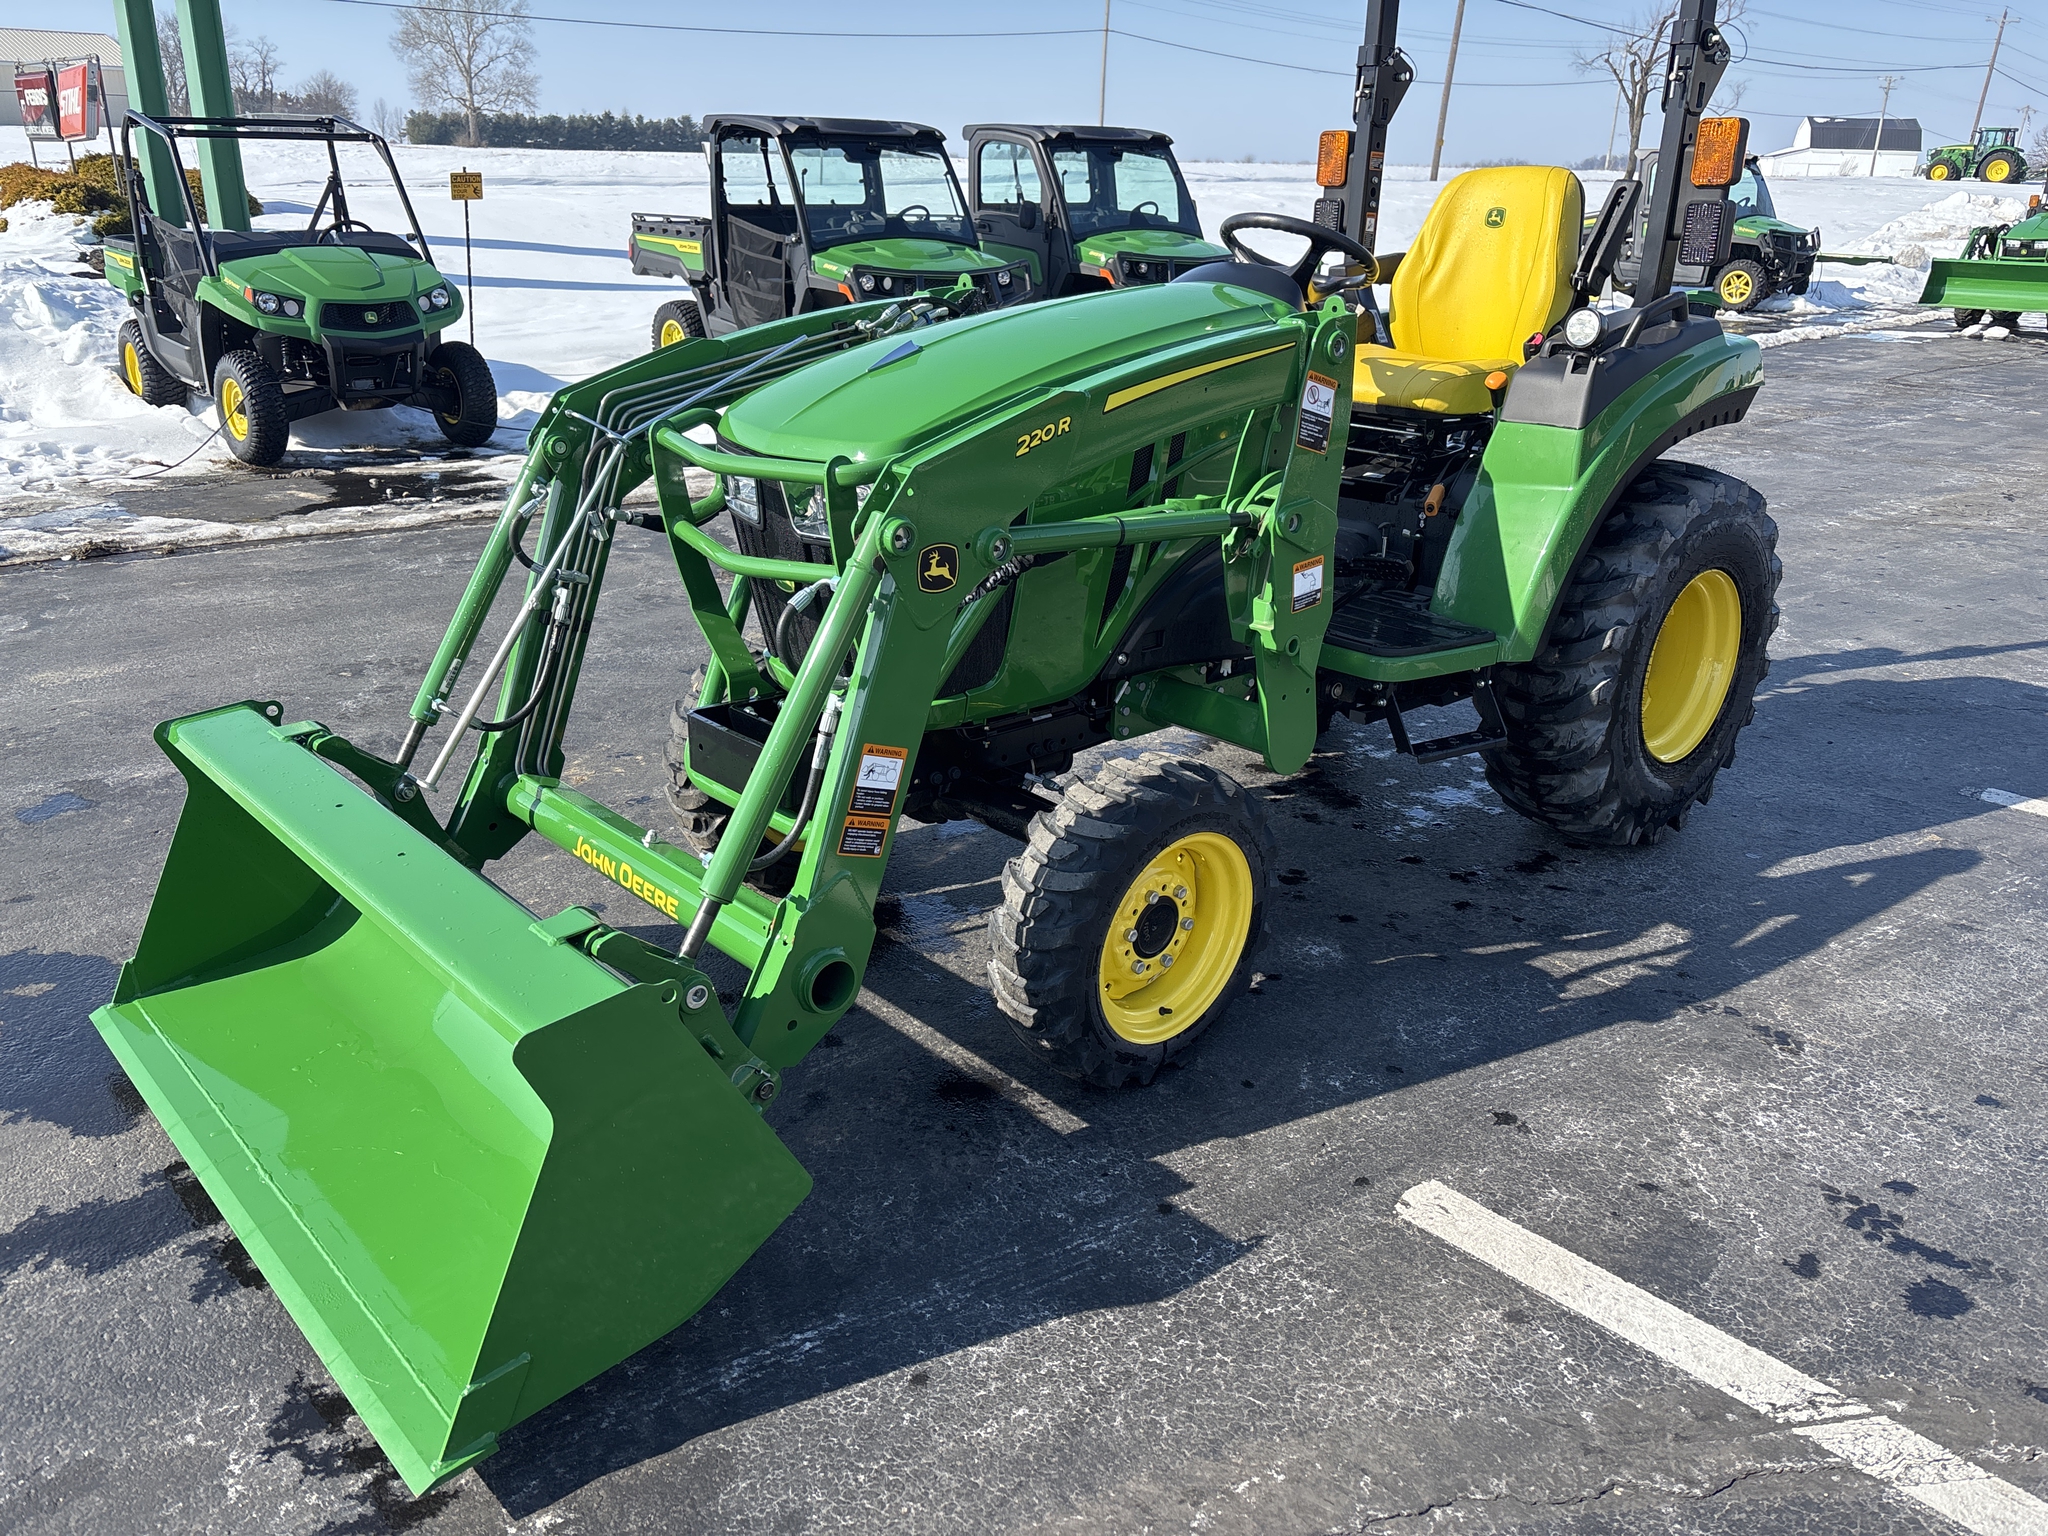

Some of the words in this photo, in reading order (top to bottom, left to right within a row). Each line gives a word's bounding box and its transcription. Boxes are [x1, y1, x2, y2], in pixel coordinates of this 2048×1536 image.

[60, 86, 81, 117] STIHL
[452, 175, 481, 183] CAUTION
[1313, 374, 1337, 388] WARNING
[1300, 557, 1322, 570] WARNING
[875, 748, 902, 757] WARNING
[857, 820, 885, 828] WARNING
[572, 836, 616, 880] JOHN
[619, 862, 679, 920] DEERE
